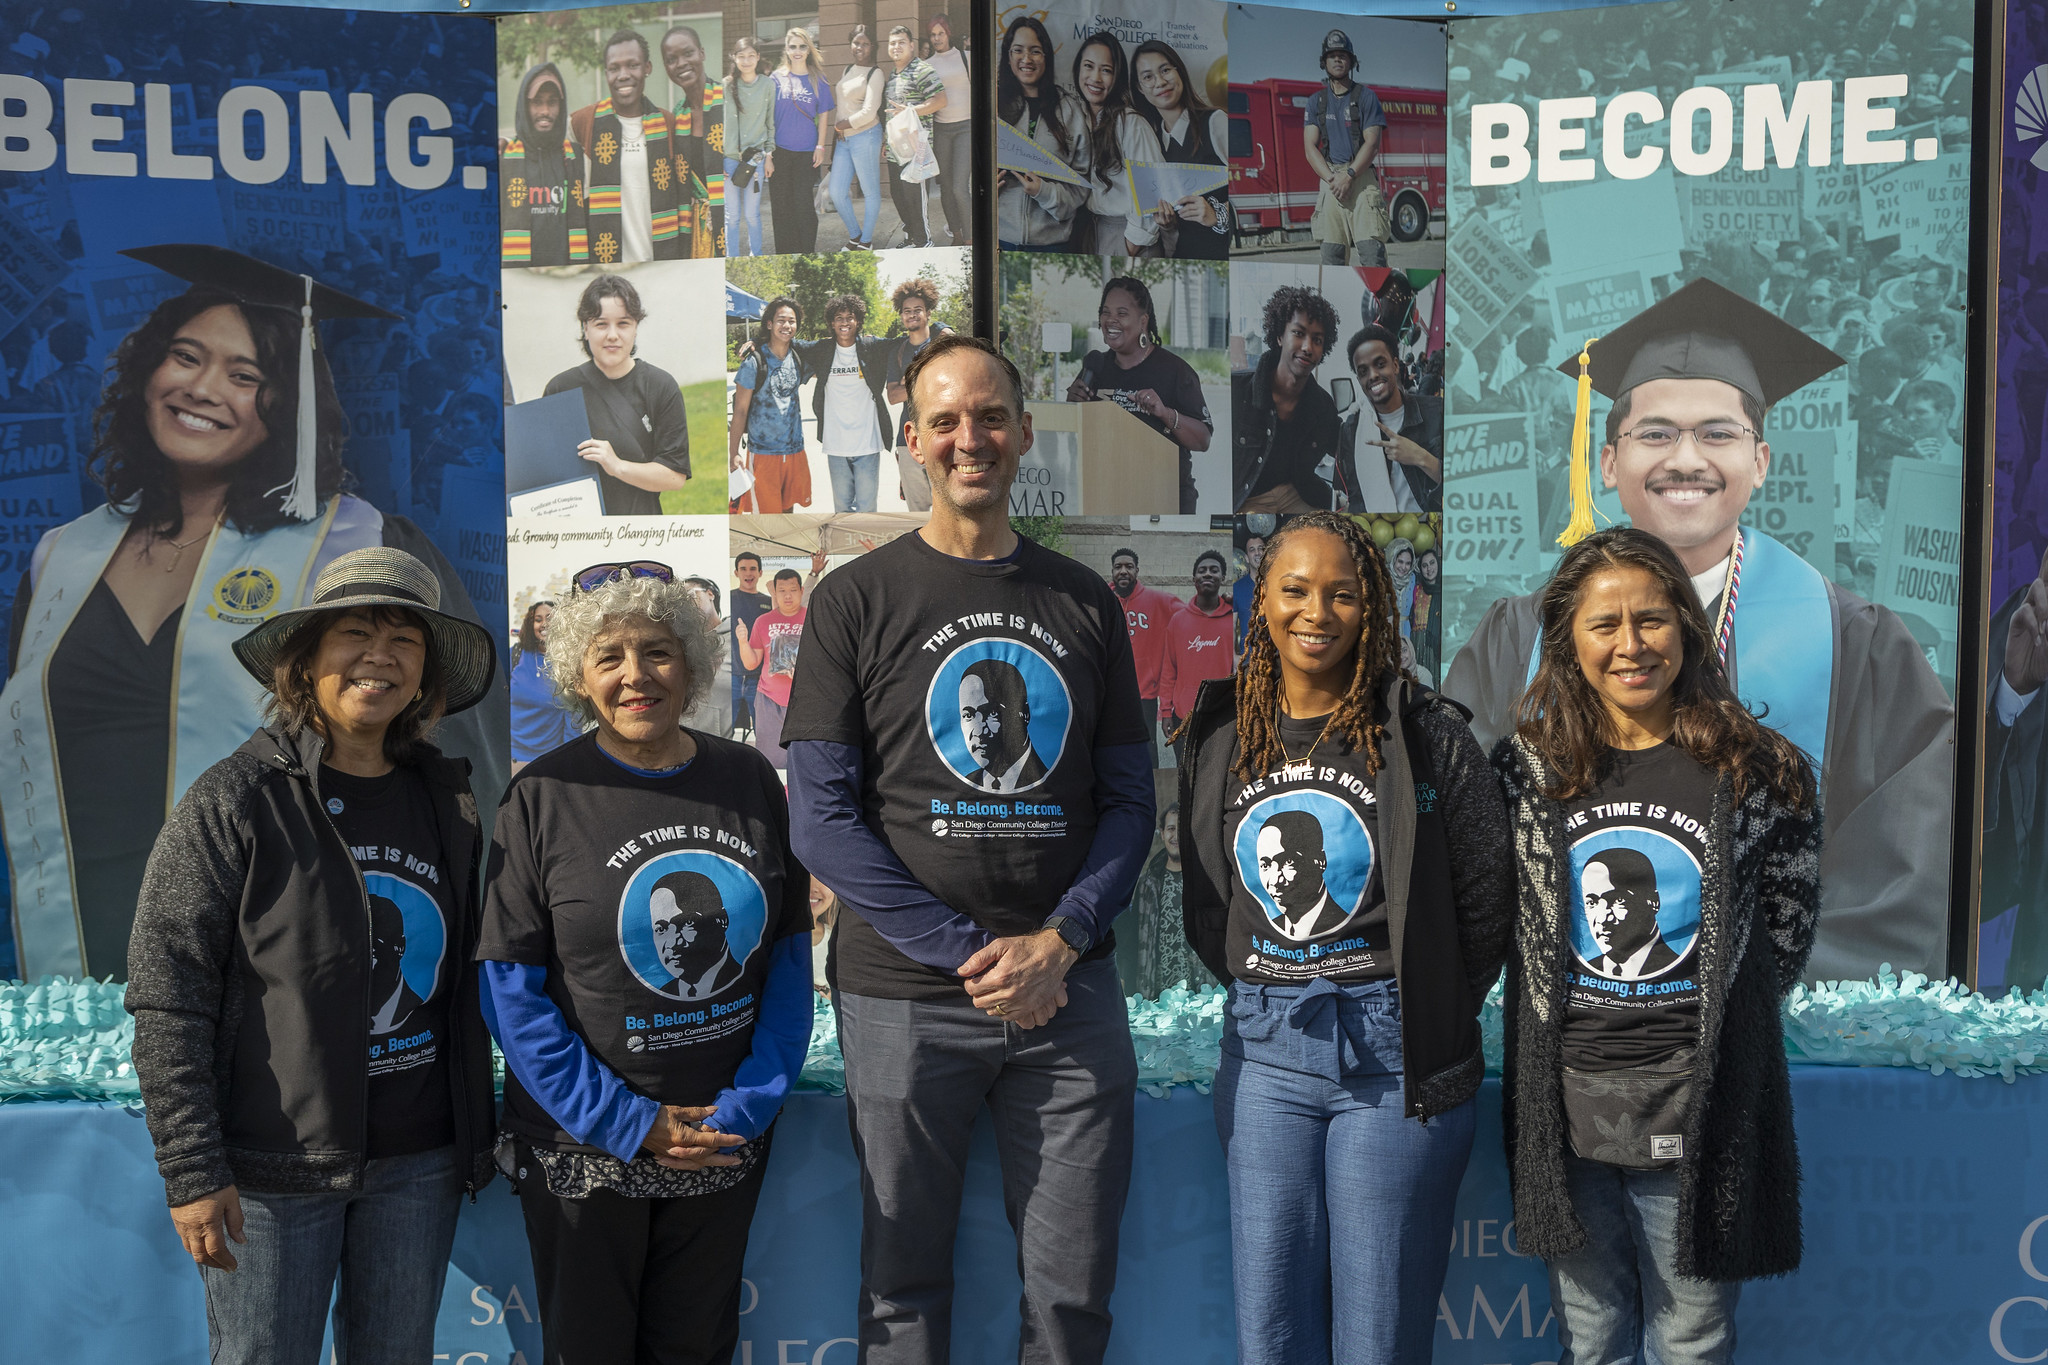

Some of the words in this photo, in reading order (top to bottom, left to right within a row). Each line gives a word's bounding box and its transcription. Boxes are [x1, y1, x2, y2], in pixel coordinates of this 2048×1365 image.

[1095, 14, 1114, 26] SAN
[1115, 16, 1142, 29] DIEGO
[1166, 21, 1196, 31] Transfer
[1073, 23, 1108, 41] MES
[1166, 31, 1191, 40] Career
[1381, 102, 1413, 115] OUNTY
[1416, 104, 1438, 116] FIRE
[0, 73, 487, 190] BELONG.
[1470, 74, 1938, 186] BECOME.
[1816, 177, 1837, 190] TO
[1868, 179, 1900, 197] VO
[1691, 187, 1796, 207] BENEVOLENT
[1927, 187, 1949, 202] U.S.
[235, 192, 341, 219] BENEVOLENT
[1934, 207, 1951, 220] TO
[247, 217, 338, 242] SOCIETY
[1702, 212, 1793, 231] SOCIETY
[1472, 225, 1501, 256] UAW
[1498, 253, 1529, 282] SAYS
[1452, 239, 1500, 286] JOBS
[1491, 281, 1516, 304] and
[1446, 258, 1500, 325] REEDOM
[1584, 278, 1614, 297] WE
[1565, 288, 1641, 321] MARCH
[1591, 312, 1622, 326] FOR
[1800, 387, 1831, 400] THE
[1446, 423, 1490, 454] WE
[1444, 440, 1525, 479] EMAND
[1014, 466, 1051, 486] EGO
[1447, 491, 1519, 511] QUAL
[1444, 515, 1523, 535] IGHTS
[522, 529, 558, 549] Growing
[561, 526, 614, 548] community.
[617, 523, 665, 547] Changing
[667, 522, 704, 543] futures.
[921, 622, 958, 653] THE
[956, 612, 1004, 630] TIME
[1009, 613, 1026, 630] IS
[1030, 622, 1069, 659] NOW
[1187, 635, 1221, 653] Legend
[1234, 778, 1266, 806] THE
[1318, 766, 1335, 782] IS
[1338, 772, 1376, 806] NOW
[931, 799, 954, 815] Be.
[956, 800, 1012, 819] Belong.
[1015, 800, 1064, 816] Become.
[951, 820, 964, 828] San
[965, 820, 986, 831] Diego
[987, 820, 1026, 831] Community
[1026, 820, 1050, 831] College
[1565, 810, 1588, 832] HE
[1591, 802, 1643, 819] TIME
[1646, 803, 1667, 820] IS
[1669, 810, 1710, 844] NOW
[605, 839, 641, 870] THE
[639, 825, 688, 846] TIME
[692, 825, 711, 840] IS
[716, 829, 758, 858] NOW
[350, 845, 379, 860] ME
[384, 845, 402, 863] IS
[404, 853, 439, 885] NOW
[1262, 940, 1308, 963] Belong.
[1309, 937, 1369, 957] Become.
[1321, 956, 1347, 968] College
[1347, 953, 1373, 964] District
[1635, 979, 1698, 996] Become.
[1570, 990, 1582, 999] San
[1583, 993, 1604, 1004] Diego
[1604, 997, 1646, 1009] Community
[625, 1016, 651, 1030] Be.
[653, 1010, 709, 1028] Belong.
[711, 993, 755, 1018] Become.
[648, 1034, 661, 1042] San
[662, 1031, 683, 1041] Diego
[684, 1022, 722, 1036] Community
[721, 1015, 741, 1028] College
[740, 1007, 754, 1019] District
[388, 1029, 434, 1053] Become.
[398, 1051, 420, 1063] College
[470, 1284, 541, 1326] SA
